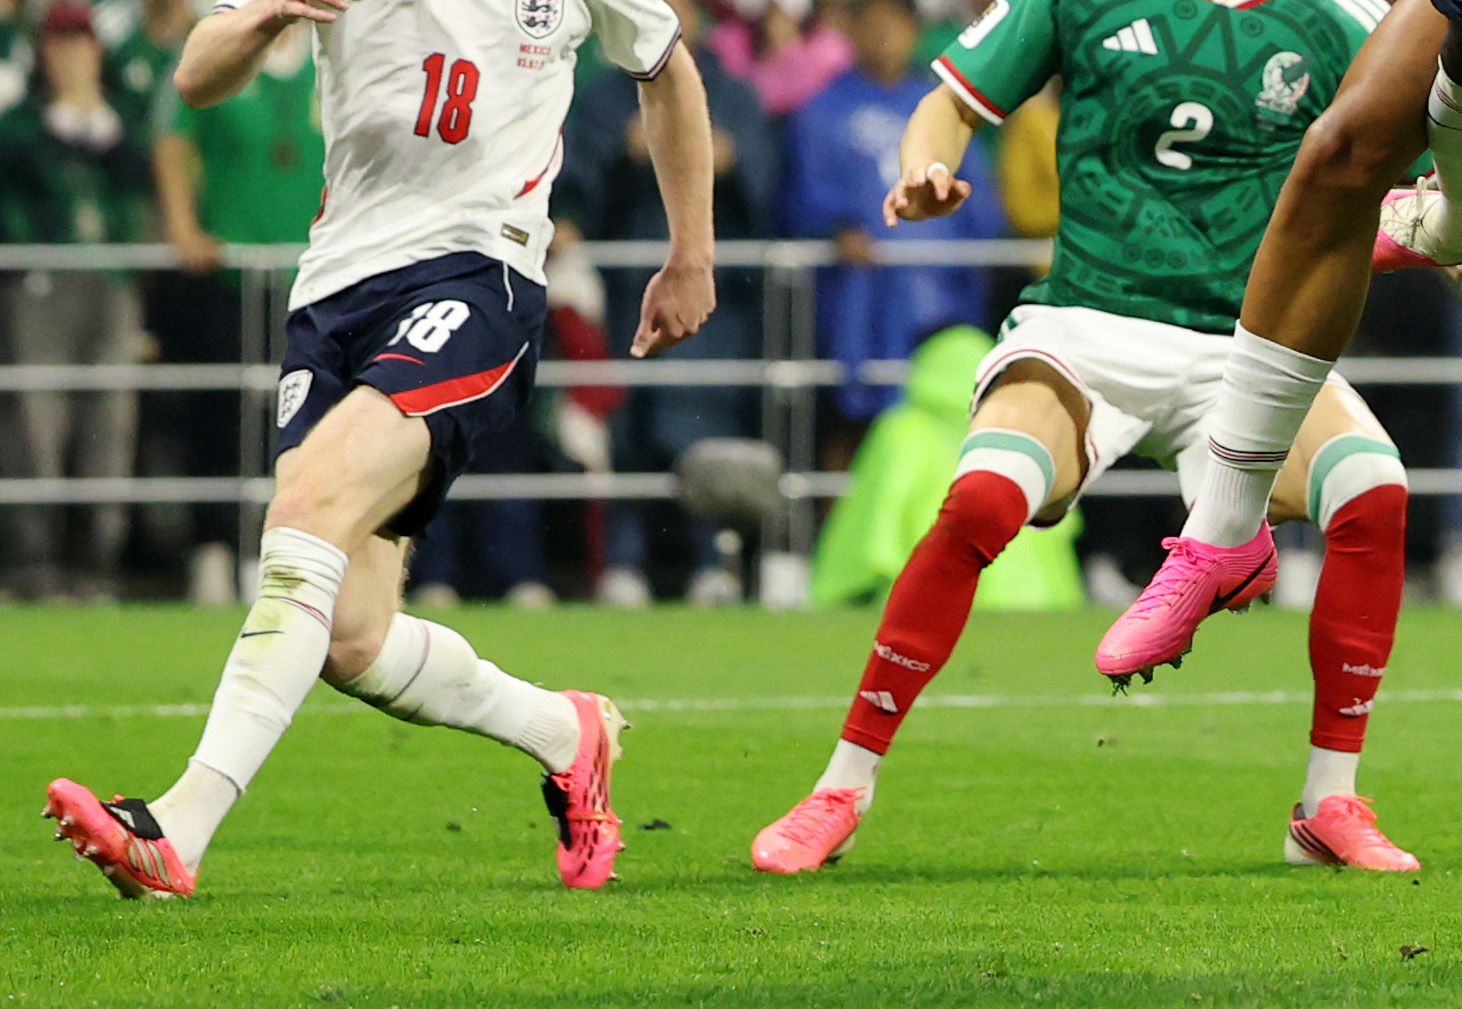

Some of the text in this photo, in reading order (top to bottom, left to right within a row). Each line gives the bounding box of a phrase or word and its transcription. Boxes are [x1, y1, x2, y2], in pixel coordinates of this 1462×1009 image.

[413, 52, 480, 145] 18
[1155, 101, 1214, 170] 2
[386, 299, 471, 353] 18
